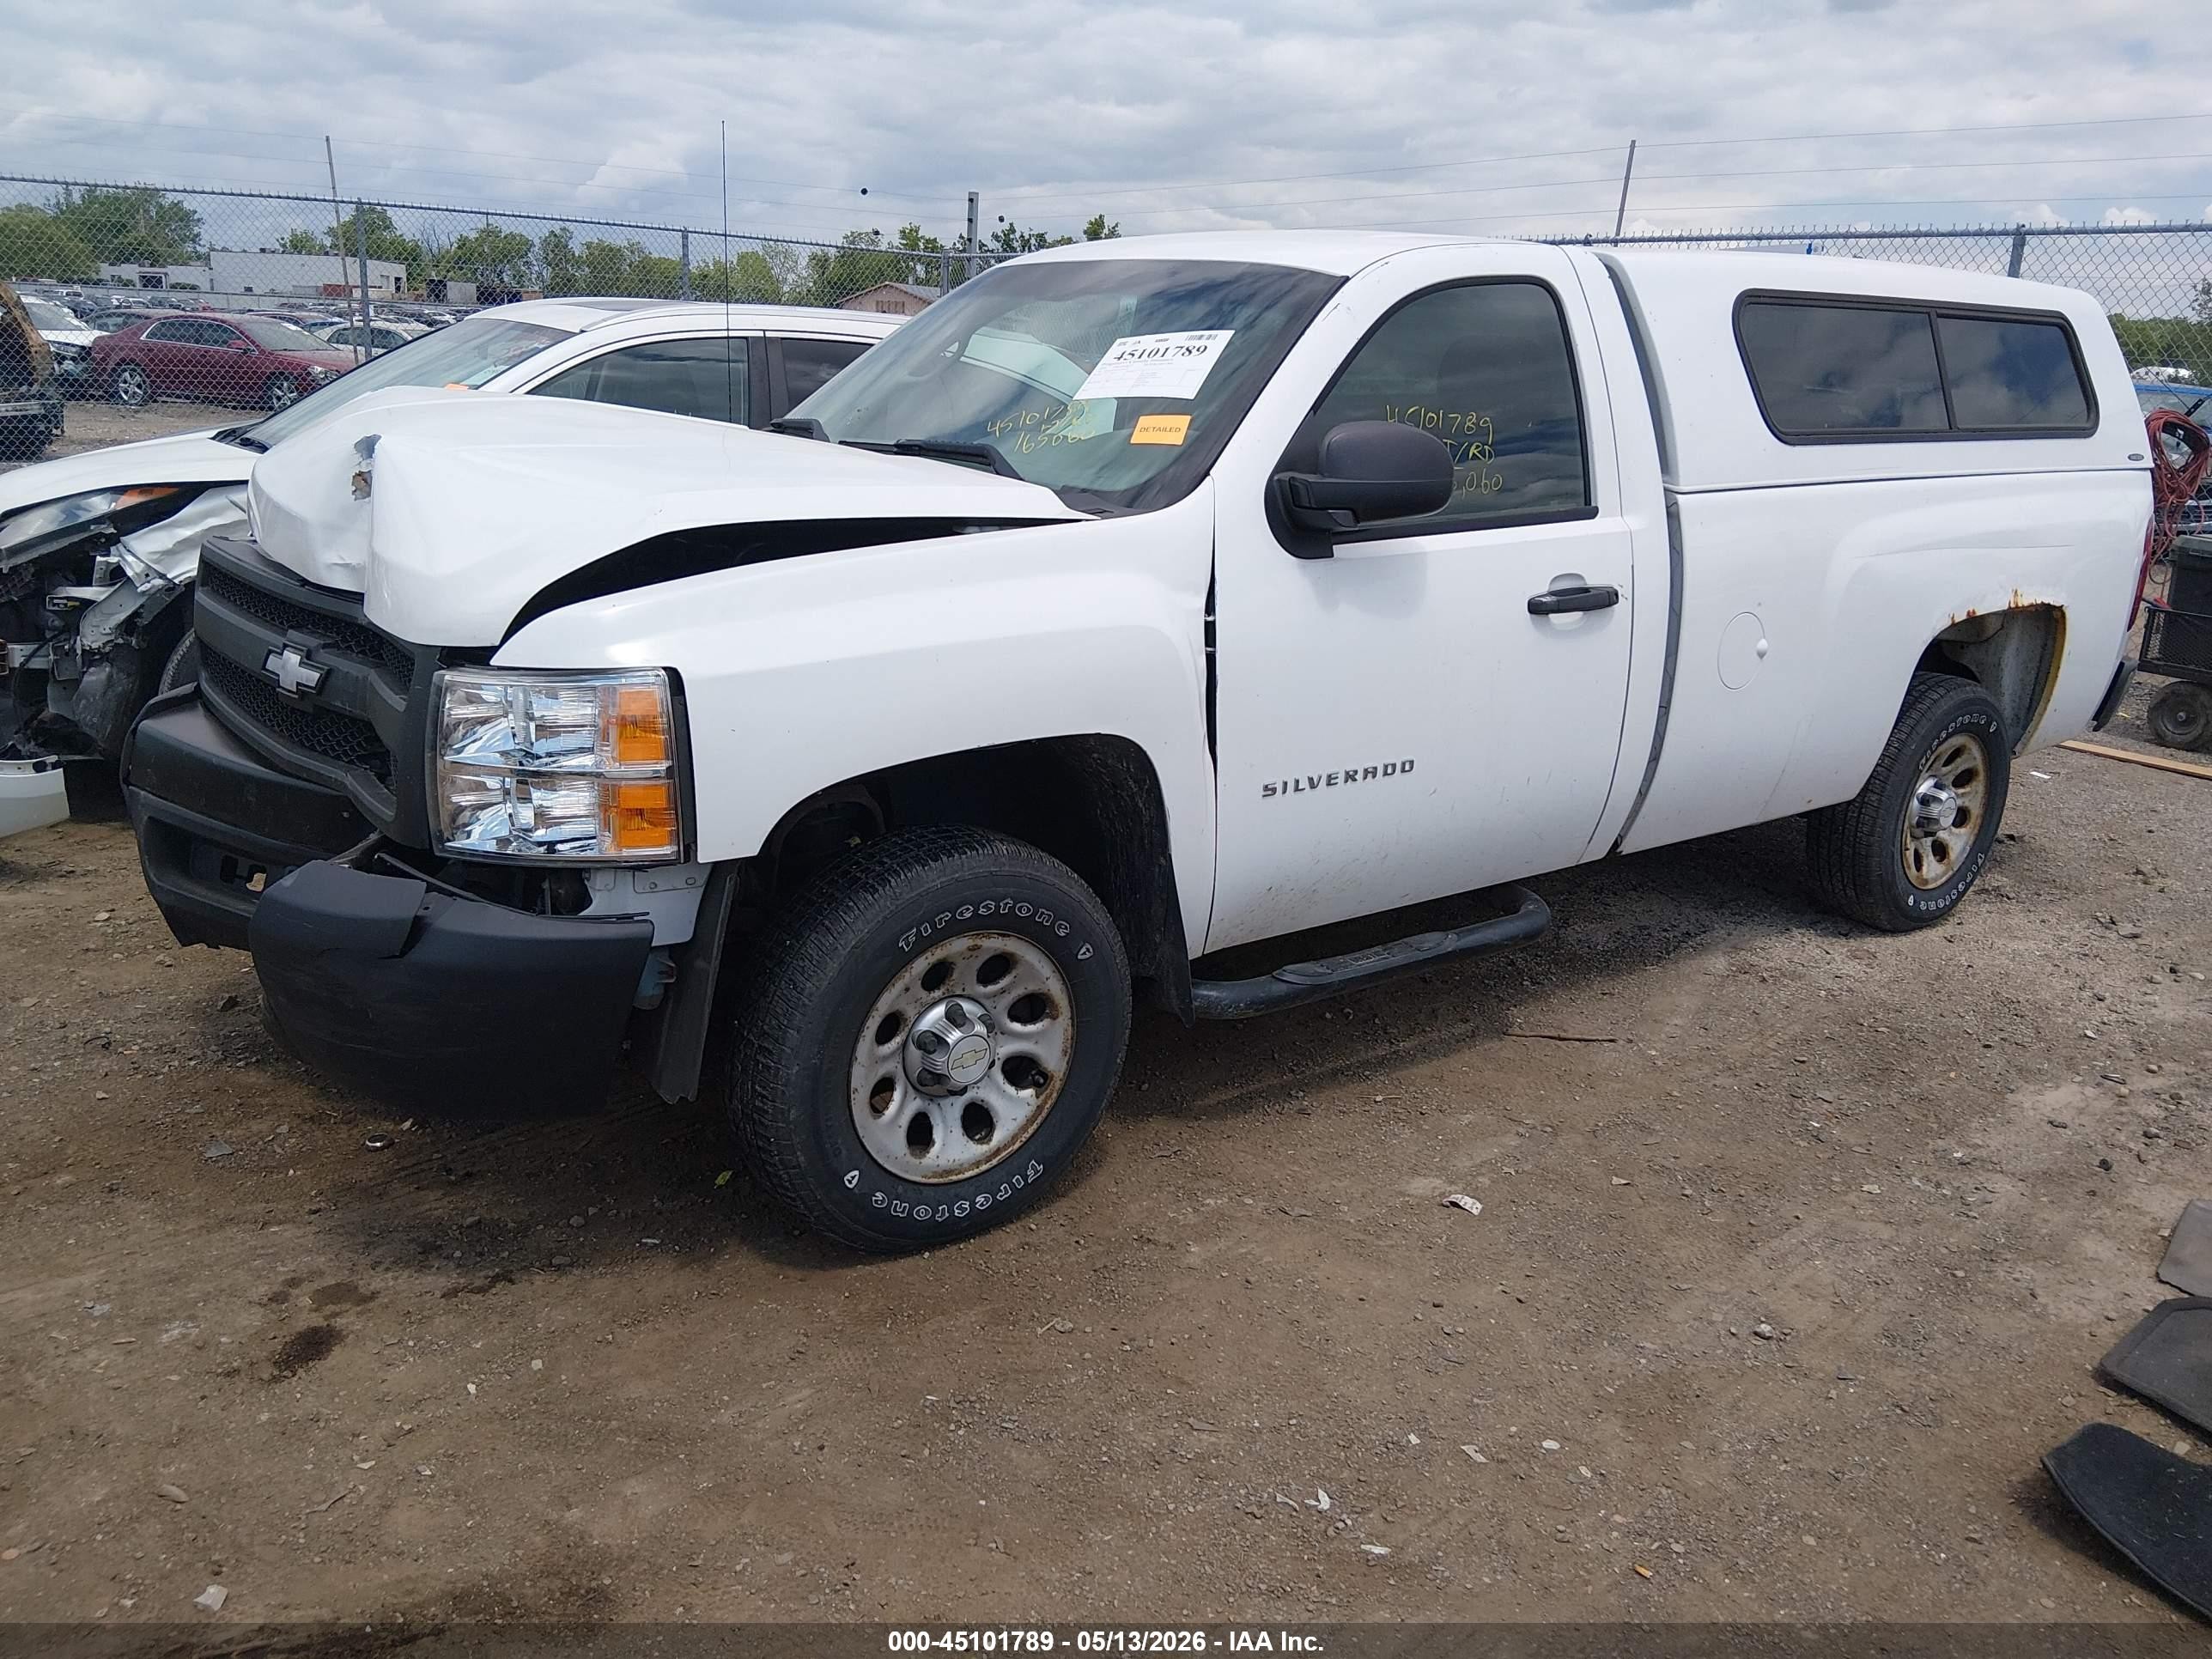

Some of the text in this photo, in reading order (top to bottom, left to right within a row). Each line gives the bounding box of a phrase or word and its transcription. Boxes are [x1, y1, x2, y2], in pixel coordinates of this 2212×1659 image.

[1114, 343, 1208, 362] 45101789
[1261, 759, 1415, 798] SILVERADO
[898, 898, 1072, 951] Firestone
[872, 1160, 1044, 1222] Firestone
